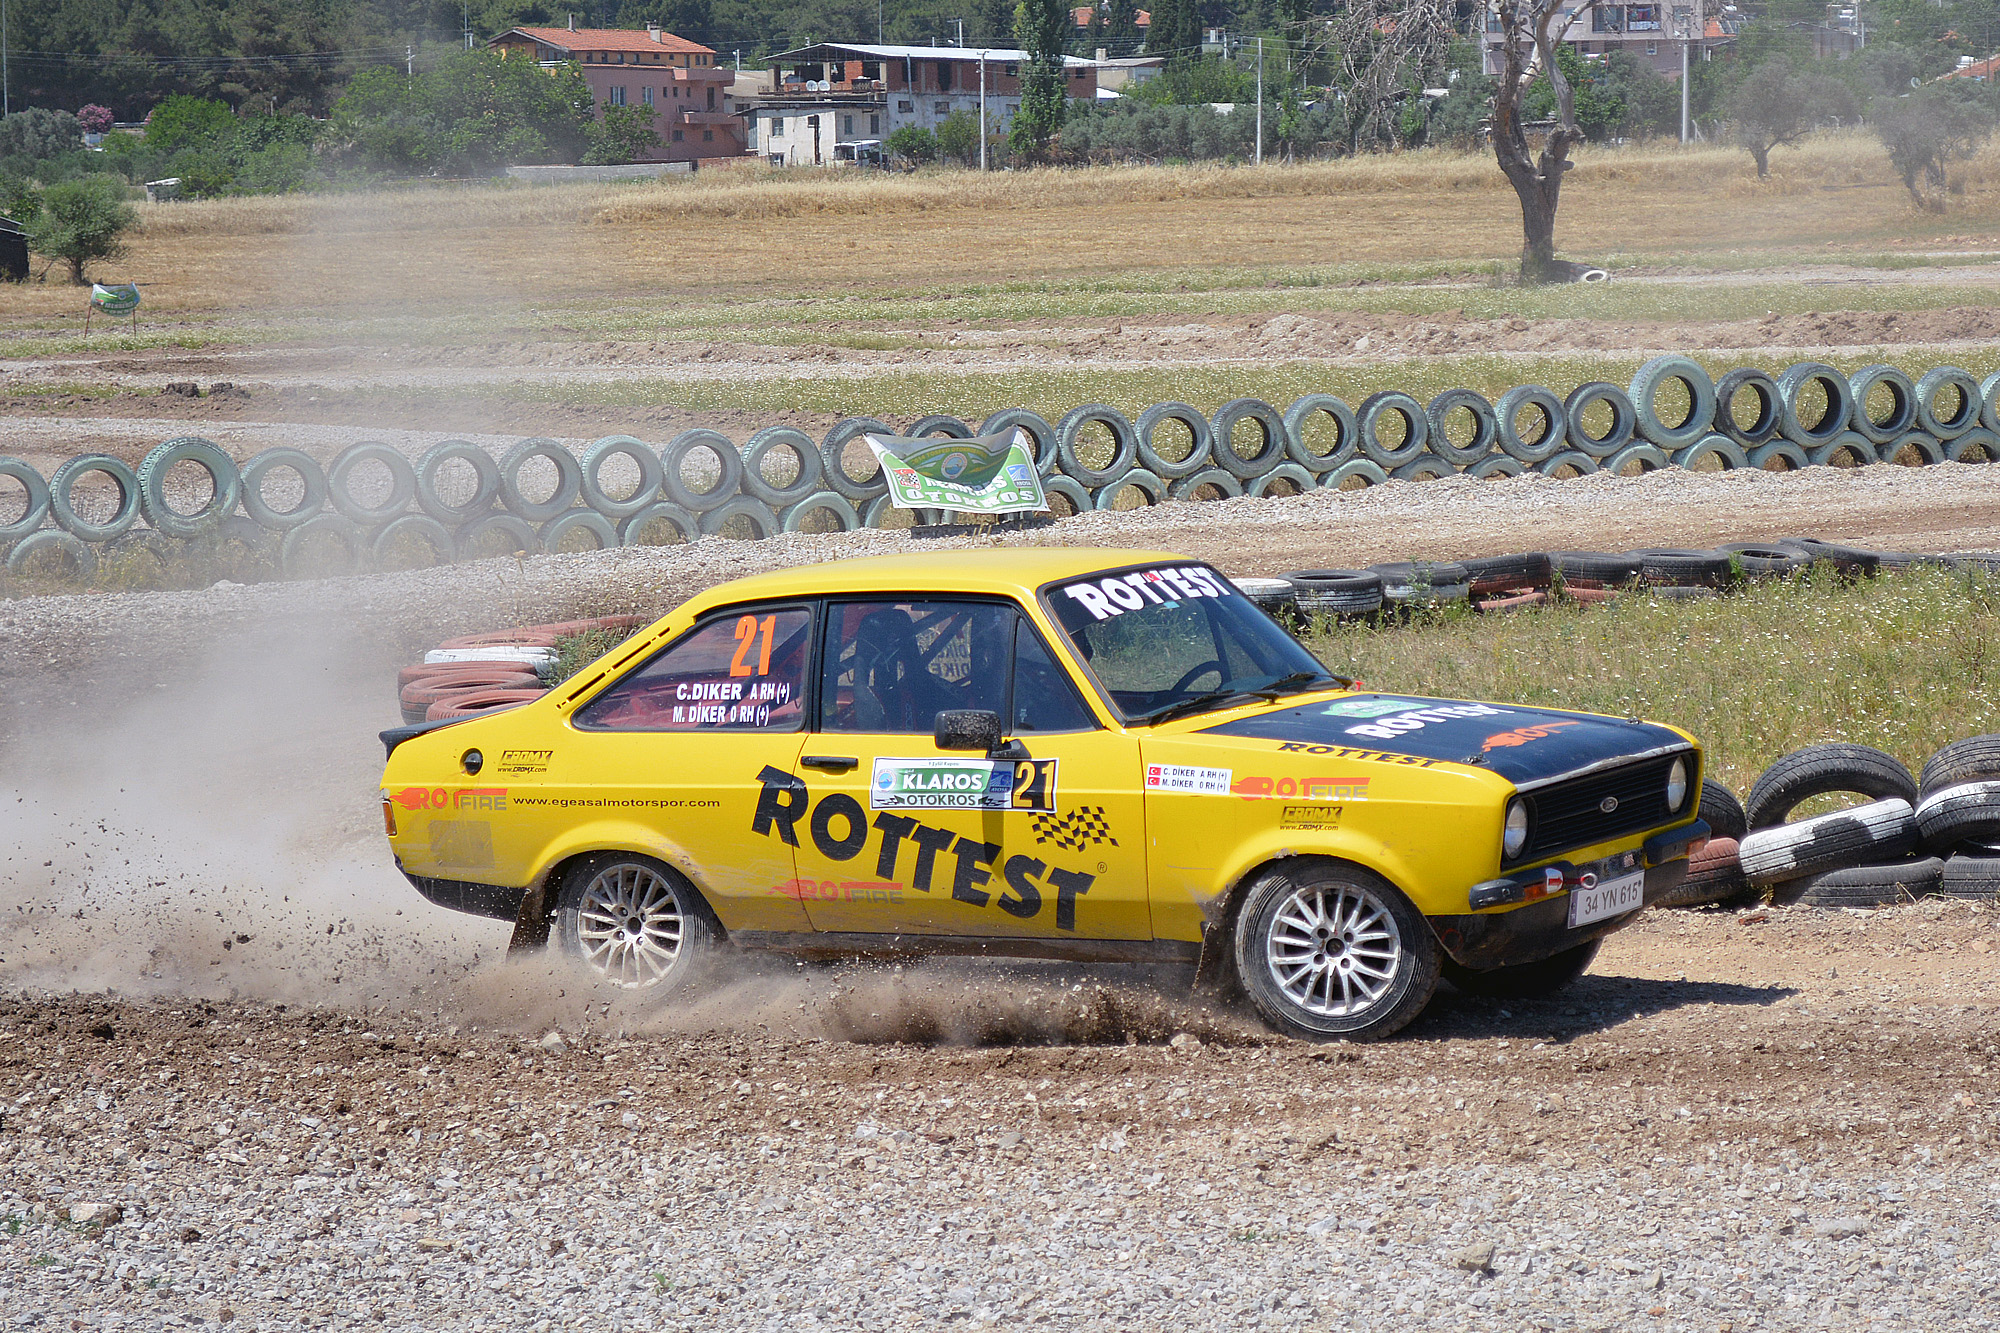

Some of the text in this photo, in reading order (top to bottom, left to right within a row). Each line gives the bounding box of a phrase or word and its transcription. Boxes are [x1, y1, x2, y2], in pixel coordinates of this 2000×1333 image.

[906, 489, 1035, 508] OTOKROS
[1064, 567, 1231, 620] ROTTEST
[730, 615, 776, 677] 21
[676, 683, 790, 704] C.DIKER A RH (+)
[672, 706, 685, 723] M.
[688, 702, 726, 723] DİKER
[740, 706, 754, 723] RH
[756, 705, 770, 727] (+)
[1345, 703, 1514, 739] ROTTEST
[501, 750, 553, 762] CROMX
[1277, 742, 1445, 768] ROTTEST
[903, 773, 983, 790] KLAROS
[1163, 766, 1228, 781] C. DİKER A RH (+)
[1012, 761, 1055, 809] 21
[1161, 778, 1170, 787] M.
[1171, 777, 1194, 788] DİKER
[1205, 781, 1216, 790] RH
[1216, 782, 1226, 792] (+)
[513, 797, 720, 809] www.egeasalmotorspor.com
[906, 794, 977, 806] OTOKROS
[1281, 806, 1343, 820] CROMX
[751, 764, 1097, 931] ROTTEST
[1585, 881, 1638, 915] 34 YN 615
